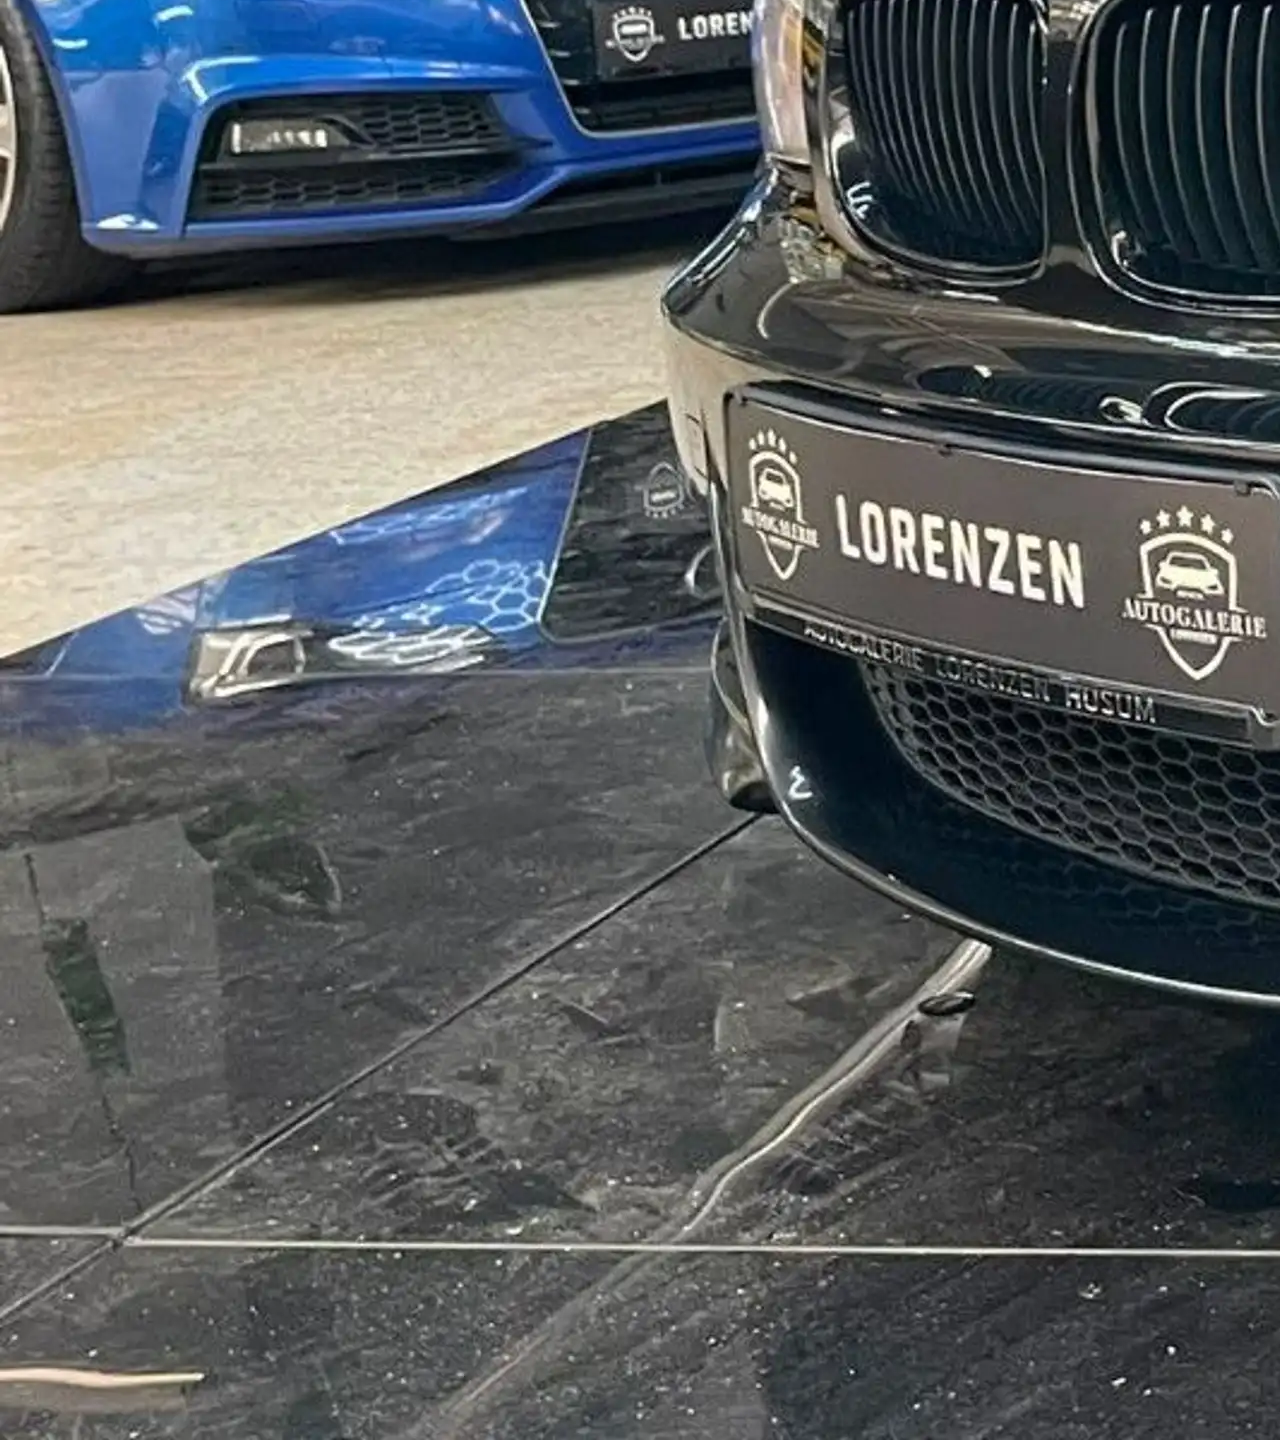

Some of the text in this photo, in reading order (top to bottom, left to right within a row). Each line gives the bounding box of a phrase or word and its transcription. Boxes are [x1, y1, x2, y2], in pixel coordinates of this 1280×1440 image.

[835, 494, 1085, 609] LORENZEN
[1122, 596, 1268, 639] AUTOGALERIE
[803, 621, 1156, 724] AUTOGALERIE LORENZEN HUSUM
